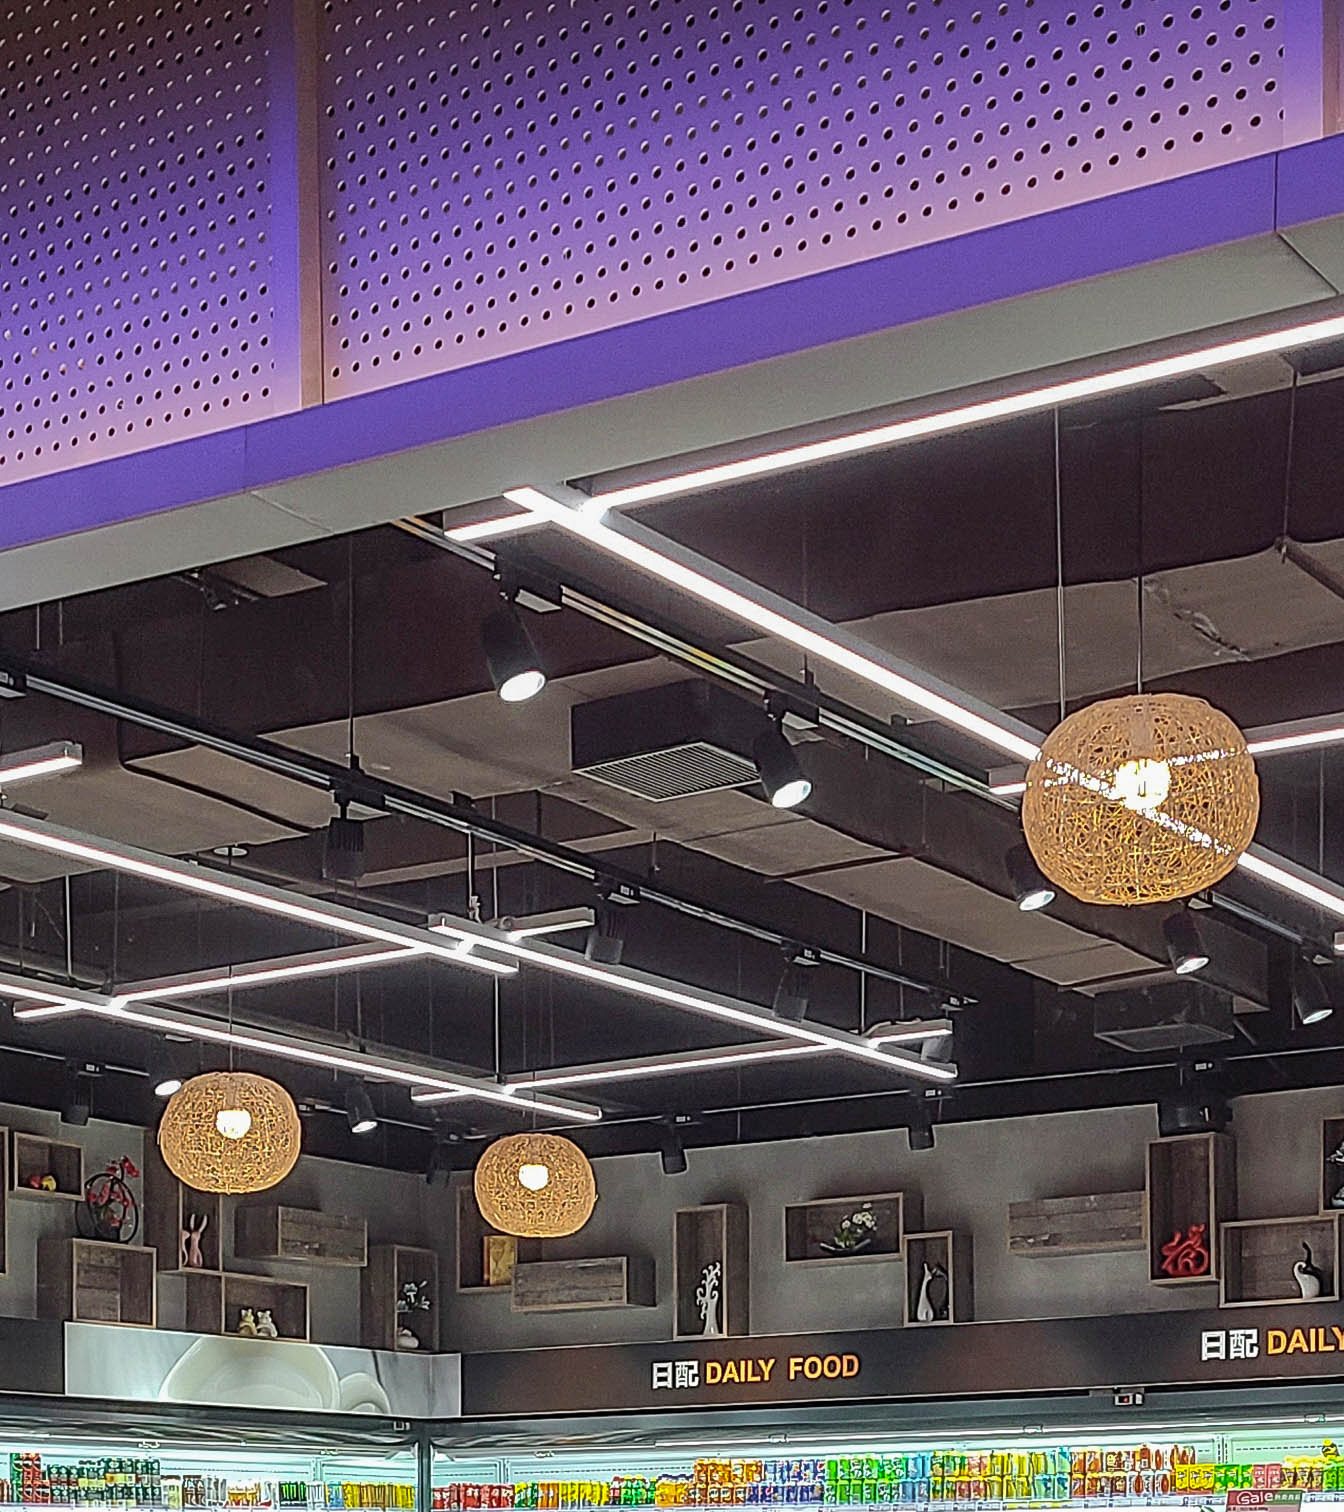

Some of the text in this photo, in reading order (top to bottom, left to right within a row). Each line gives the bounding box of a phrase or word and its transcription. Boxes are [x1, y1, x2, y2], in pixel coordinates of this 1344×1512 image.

[1201, 1329, 1259, 1361] 日配
[652, 1355, 859, 1389] 日配 DAILY FOOD
